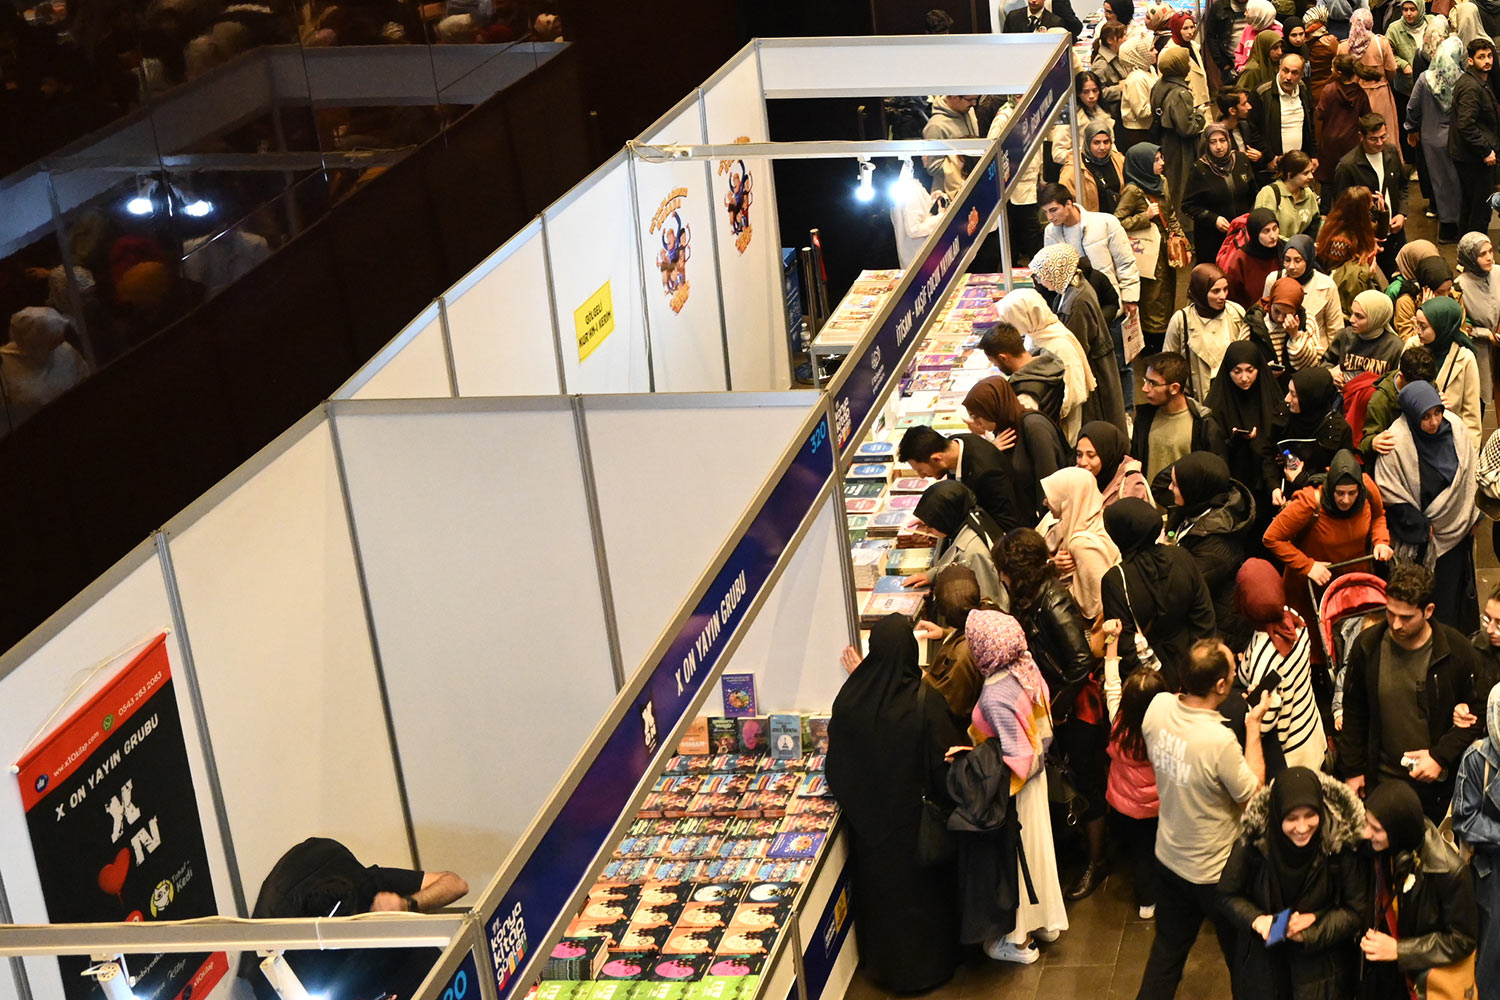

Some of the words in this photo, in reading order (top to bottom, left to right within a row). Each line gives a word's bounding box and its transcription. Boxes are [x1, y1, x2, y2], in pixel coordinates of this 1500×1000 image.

[896, 309, 913, 347] İTİSAM
[927, 265, 942, 303] ÇOCUK
[810, 420, 827, 454] 320
[674, 667, 684, 697] X
[683, 648, 697, 685] ON
[695, 609, 722, 662] YAYIN
[720, 568, 748, 626] GRUBU
[118, 697, 135, 717] 0543
[55, 803, 66, 822] X
[69, 785, 87, 809] ON
[88, 749, 122, 791] YAYIN
[123, 713, 159, 756] GRUBU
[176, 869, 193, 893] Kedi
[490, 901, 522, 953] konya
[493, 916, 525, 969] kitap
